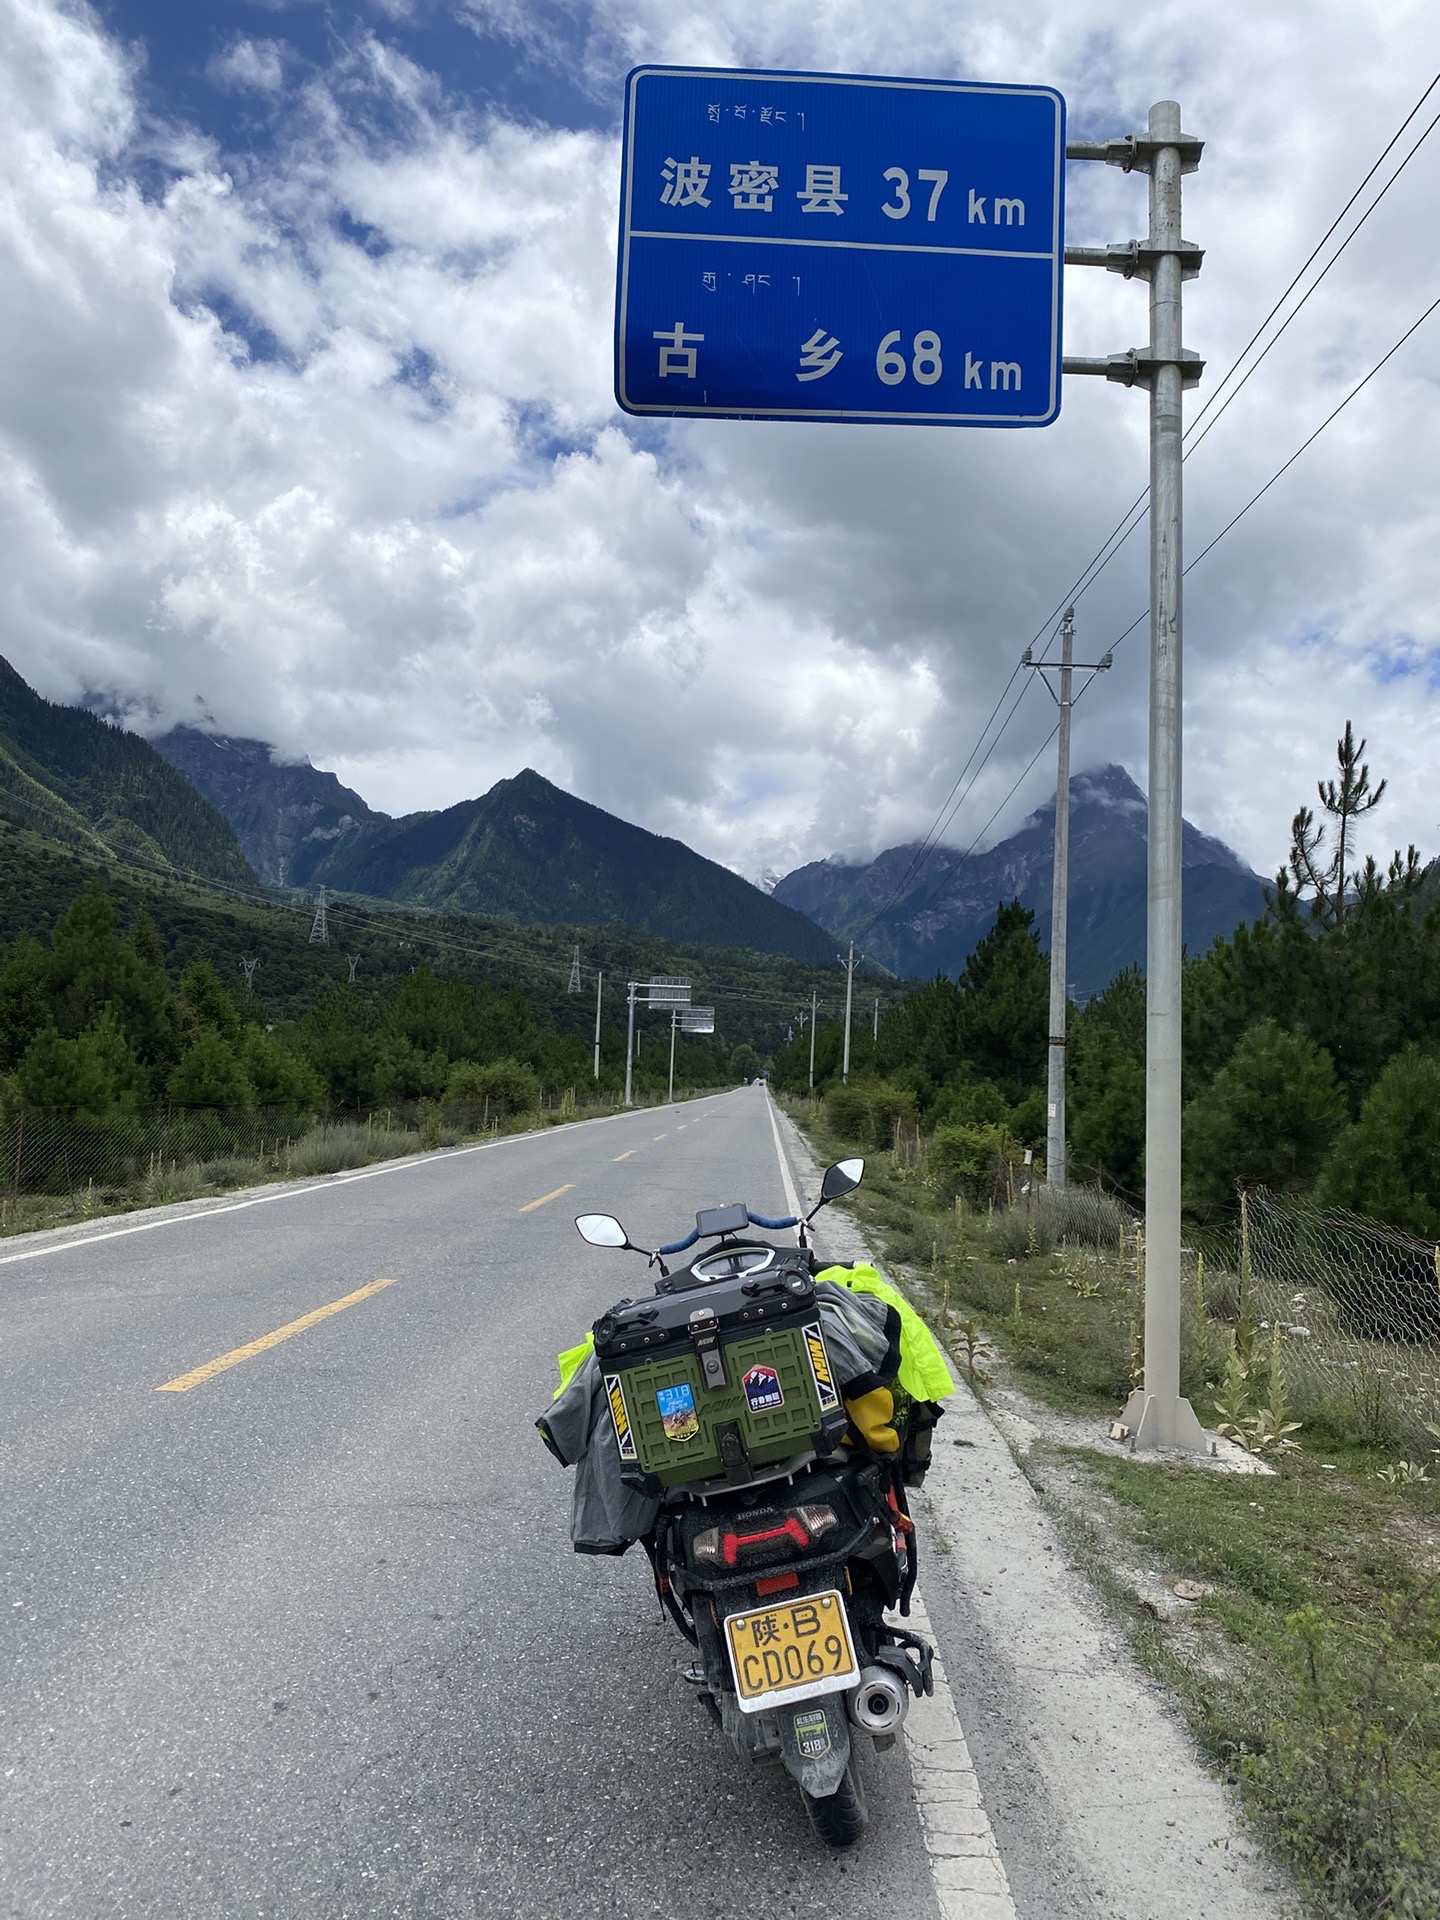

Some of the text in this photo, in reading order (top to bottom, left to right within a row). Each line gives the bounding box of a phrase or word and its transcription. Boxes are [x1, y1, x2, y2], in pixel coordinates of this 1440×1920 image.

[659, 156, 1026, 226] 波密县 37 km
[876, 329, 943, 386] 68
[964, 351, 1022, 391] km
[737, 1506, 774, 1520] HONDA
[751, 1604, 821, 1648] 陕·B
[743, 1634, 843, 1690] CD069
[802, 1739, 822, 1753] 318
